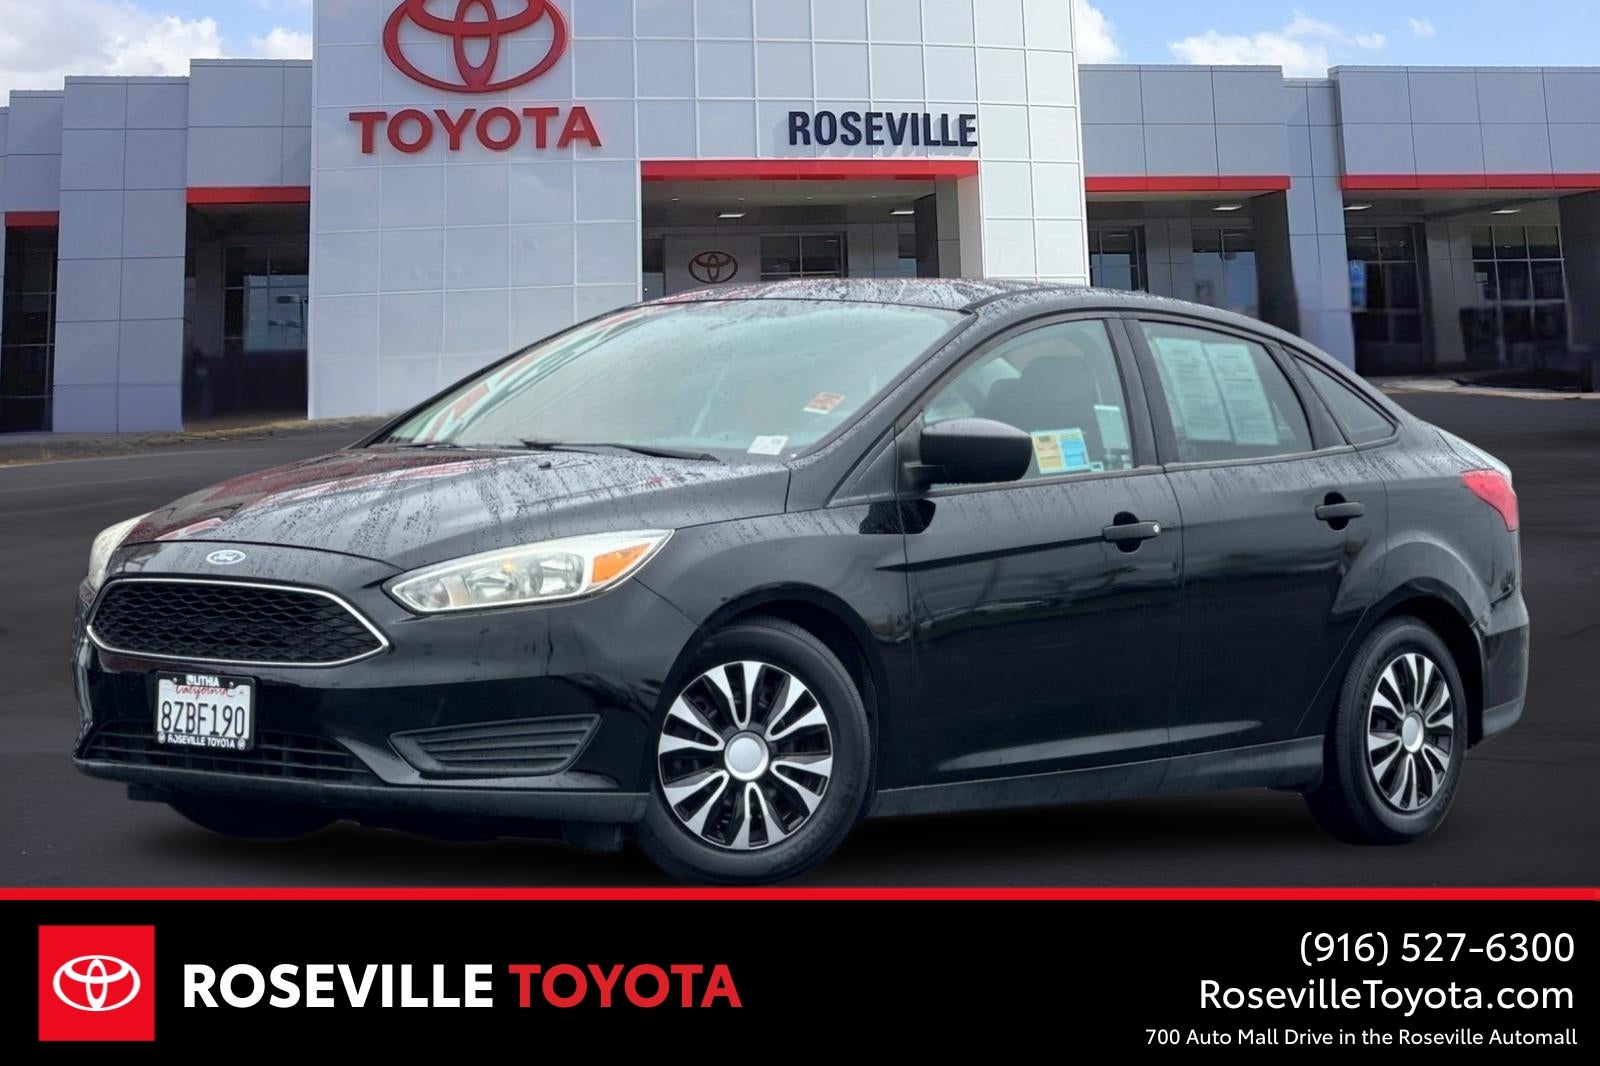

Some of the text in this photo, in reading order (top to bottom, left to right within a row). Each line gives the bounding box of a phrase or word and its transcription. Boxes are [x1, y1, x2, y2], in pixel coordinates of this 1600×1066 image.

[349, 106, 602, 154] TOYOTA
[788, 110, 978, 147] ROSEVILLE
[195, 675, 220, 687] LITHIA
[161, 700, 245, 738] 8ZBF190
[168, 734, 236, 749] ROSEVILLE TOYOTA
